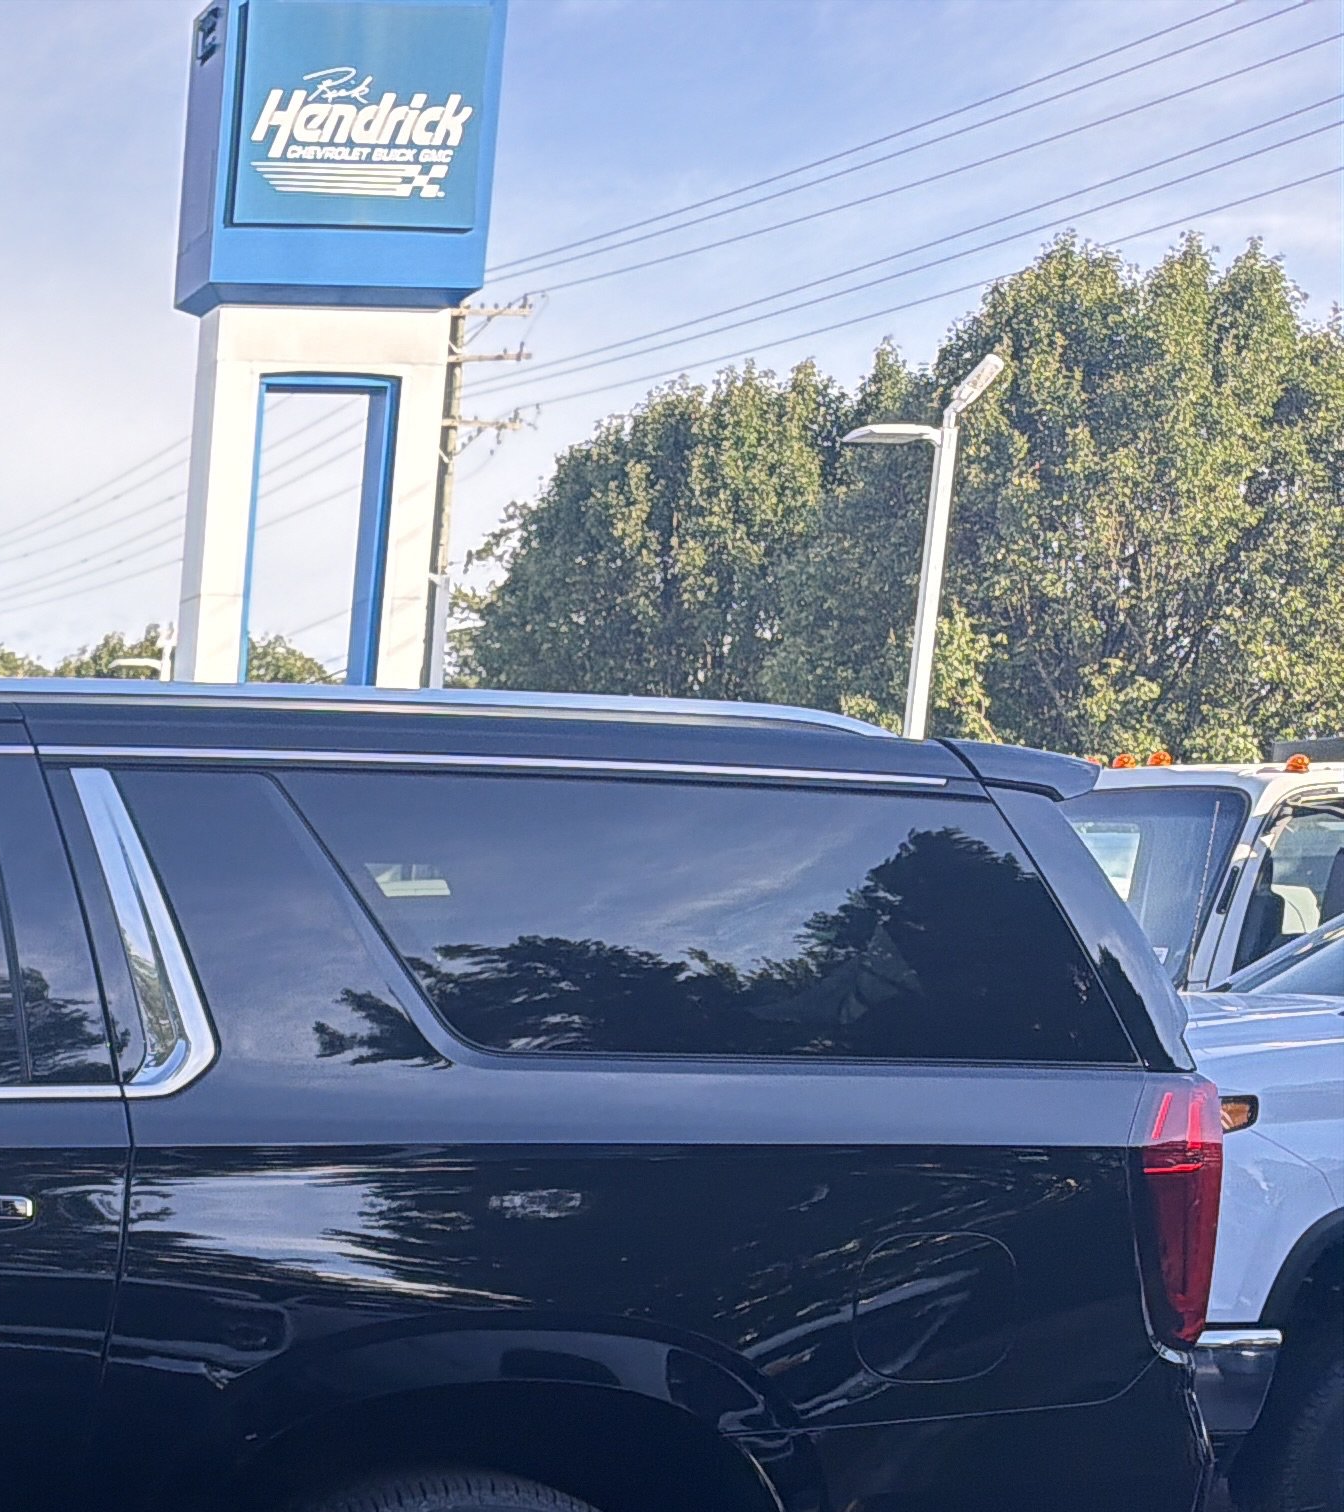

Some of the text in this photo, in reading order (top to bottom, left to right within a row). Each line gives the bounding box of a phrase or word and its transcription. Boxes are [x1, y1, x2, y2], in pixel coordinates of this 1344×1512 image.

[250, 89, 473, 158] Hendrick
[286, 144, 454, 163] CHEVROLET BUICK GMC
